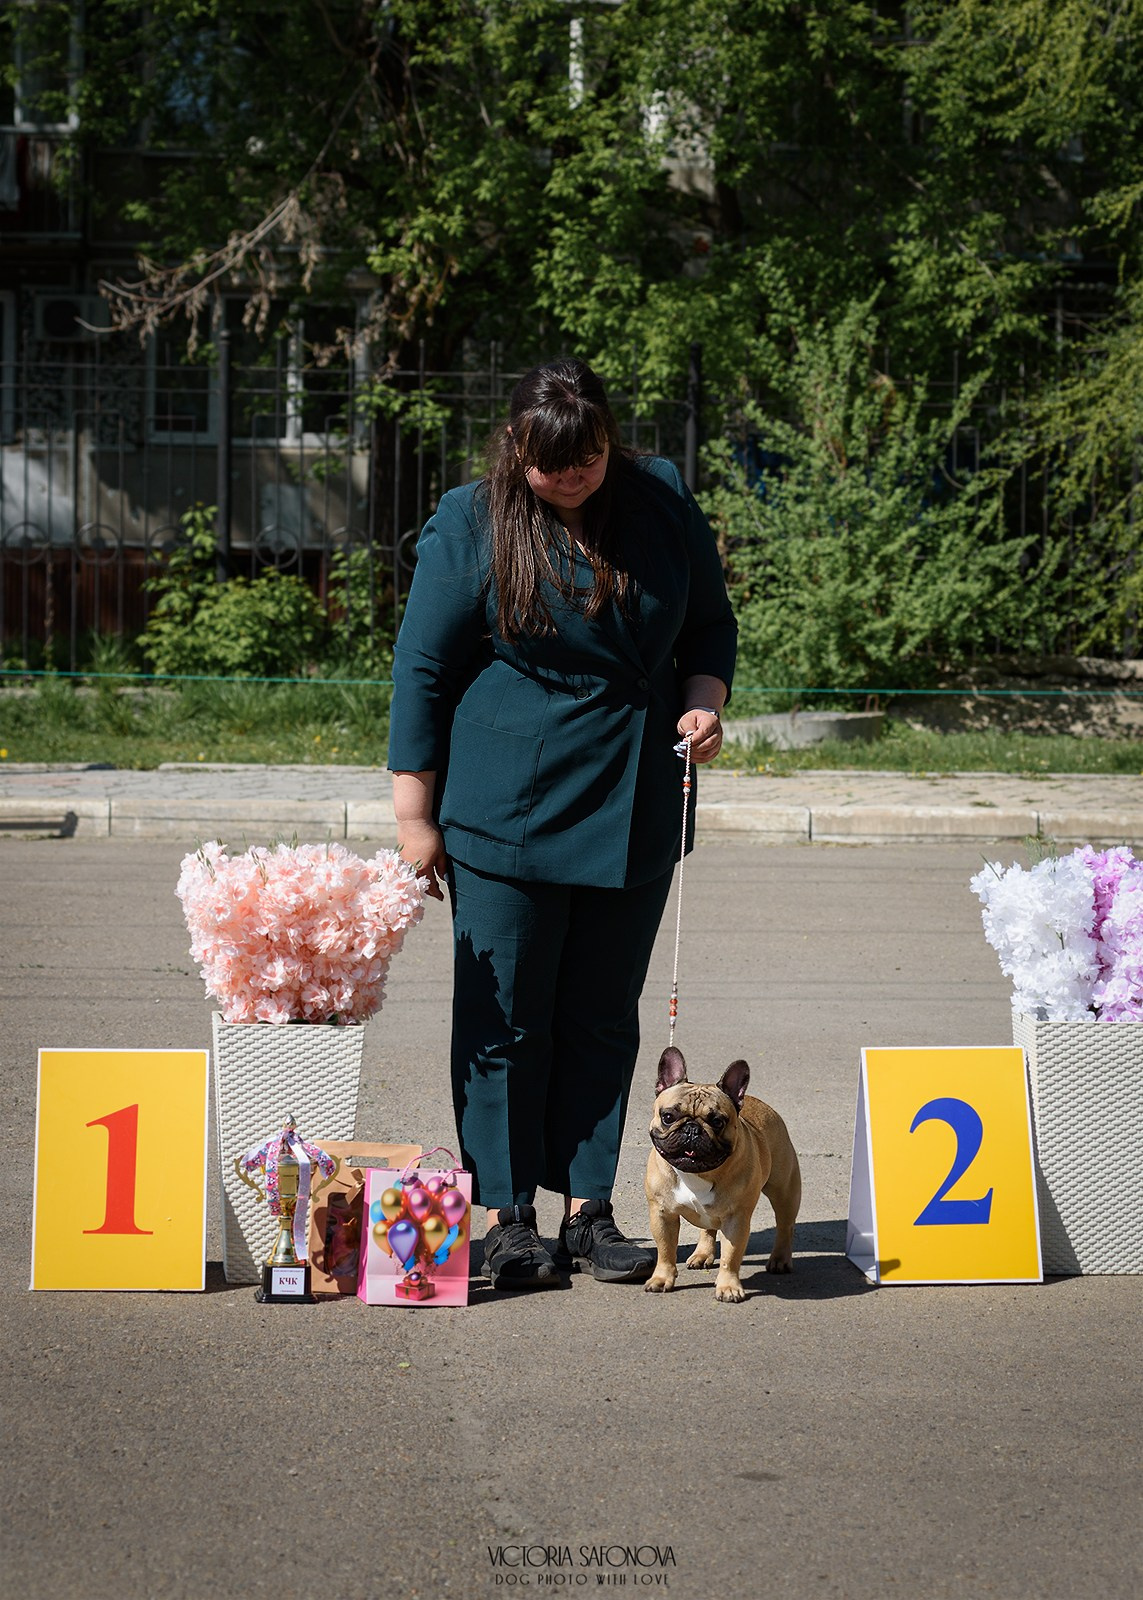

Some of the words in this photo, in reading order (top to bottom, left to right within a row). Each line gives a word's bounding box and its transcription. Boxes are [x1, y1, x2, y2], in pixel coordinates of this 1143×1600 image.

[82, 1103, 154, 1236] 1
[909, 1096, 994, 1226] 2
[279, 1277, 298, 1286] КЧК
